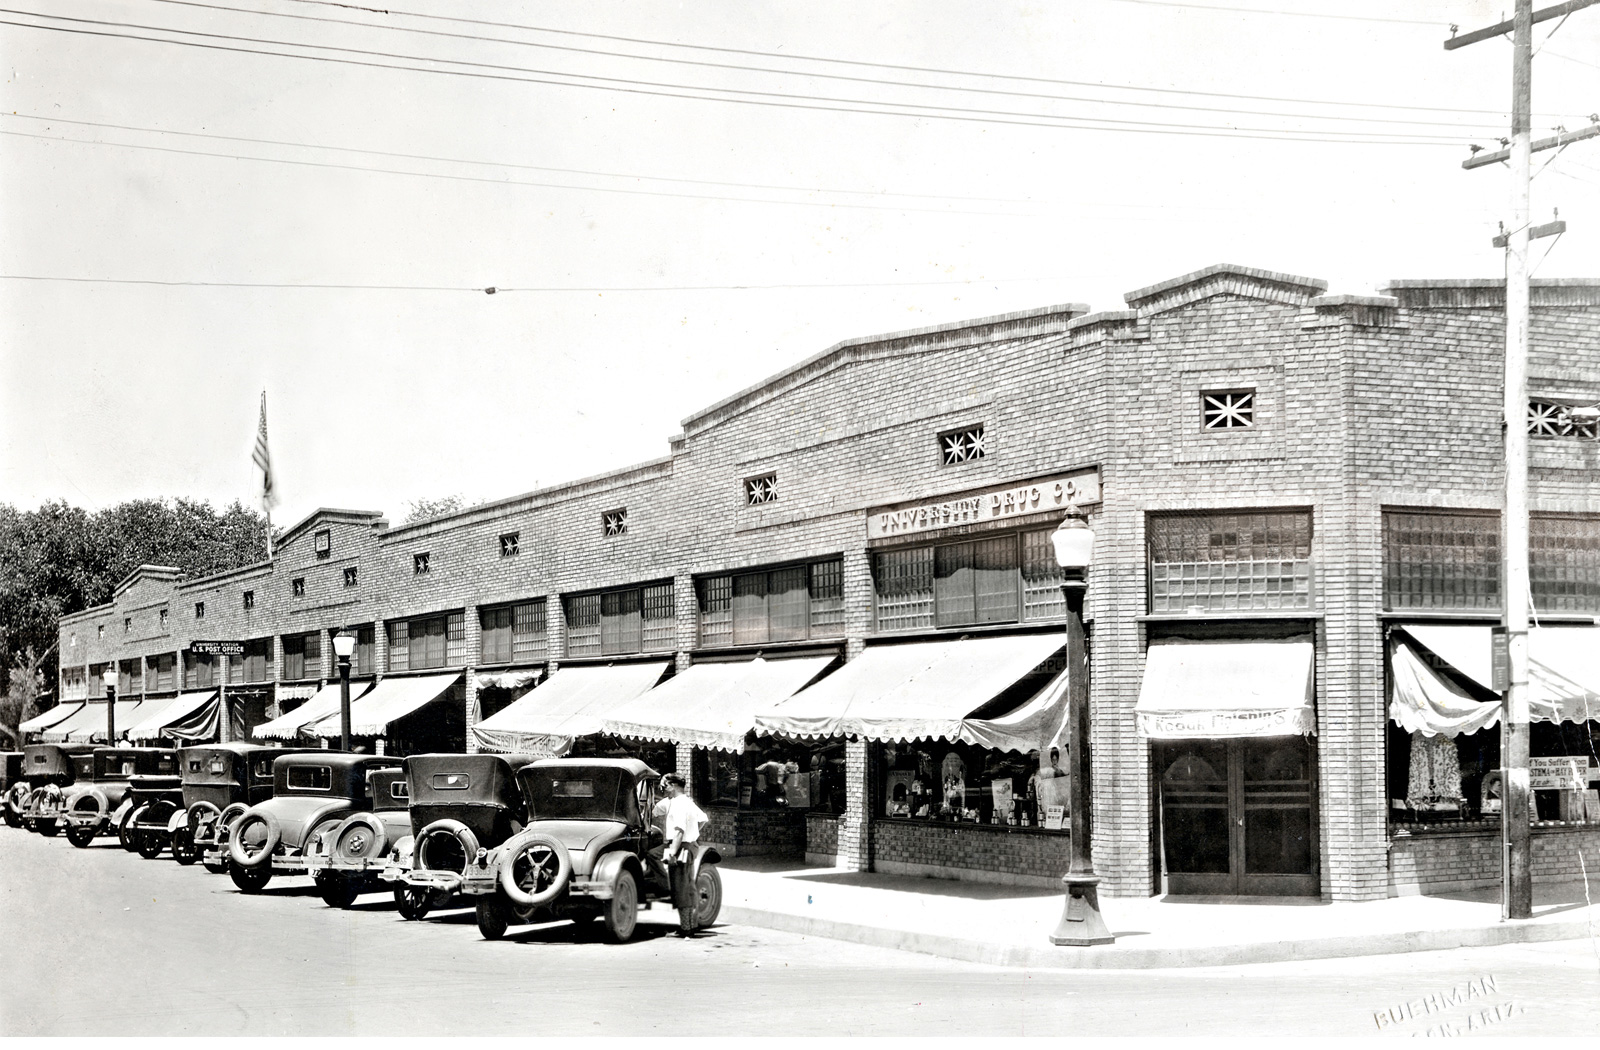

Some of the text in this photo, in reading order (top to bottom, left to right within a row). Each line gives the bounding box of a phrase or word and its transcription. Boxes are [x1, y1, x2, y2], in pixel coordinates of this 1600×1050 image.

[880, 480, 1083, 529] UNIVERSITY DRUG CO.
[1534, 758, 1547, 767] You
[1548, 758, 1570, 767] Suffer
[1529, 767, 1551, 777] STHMA
